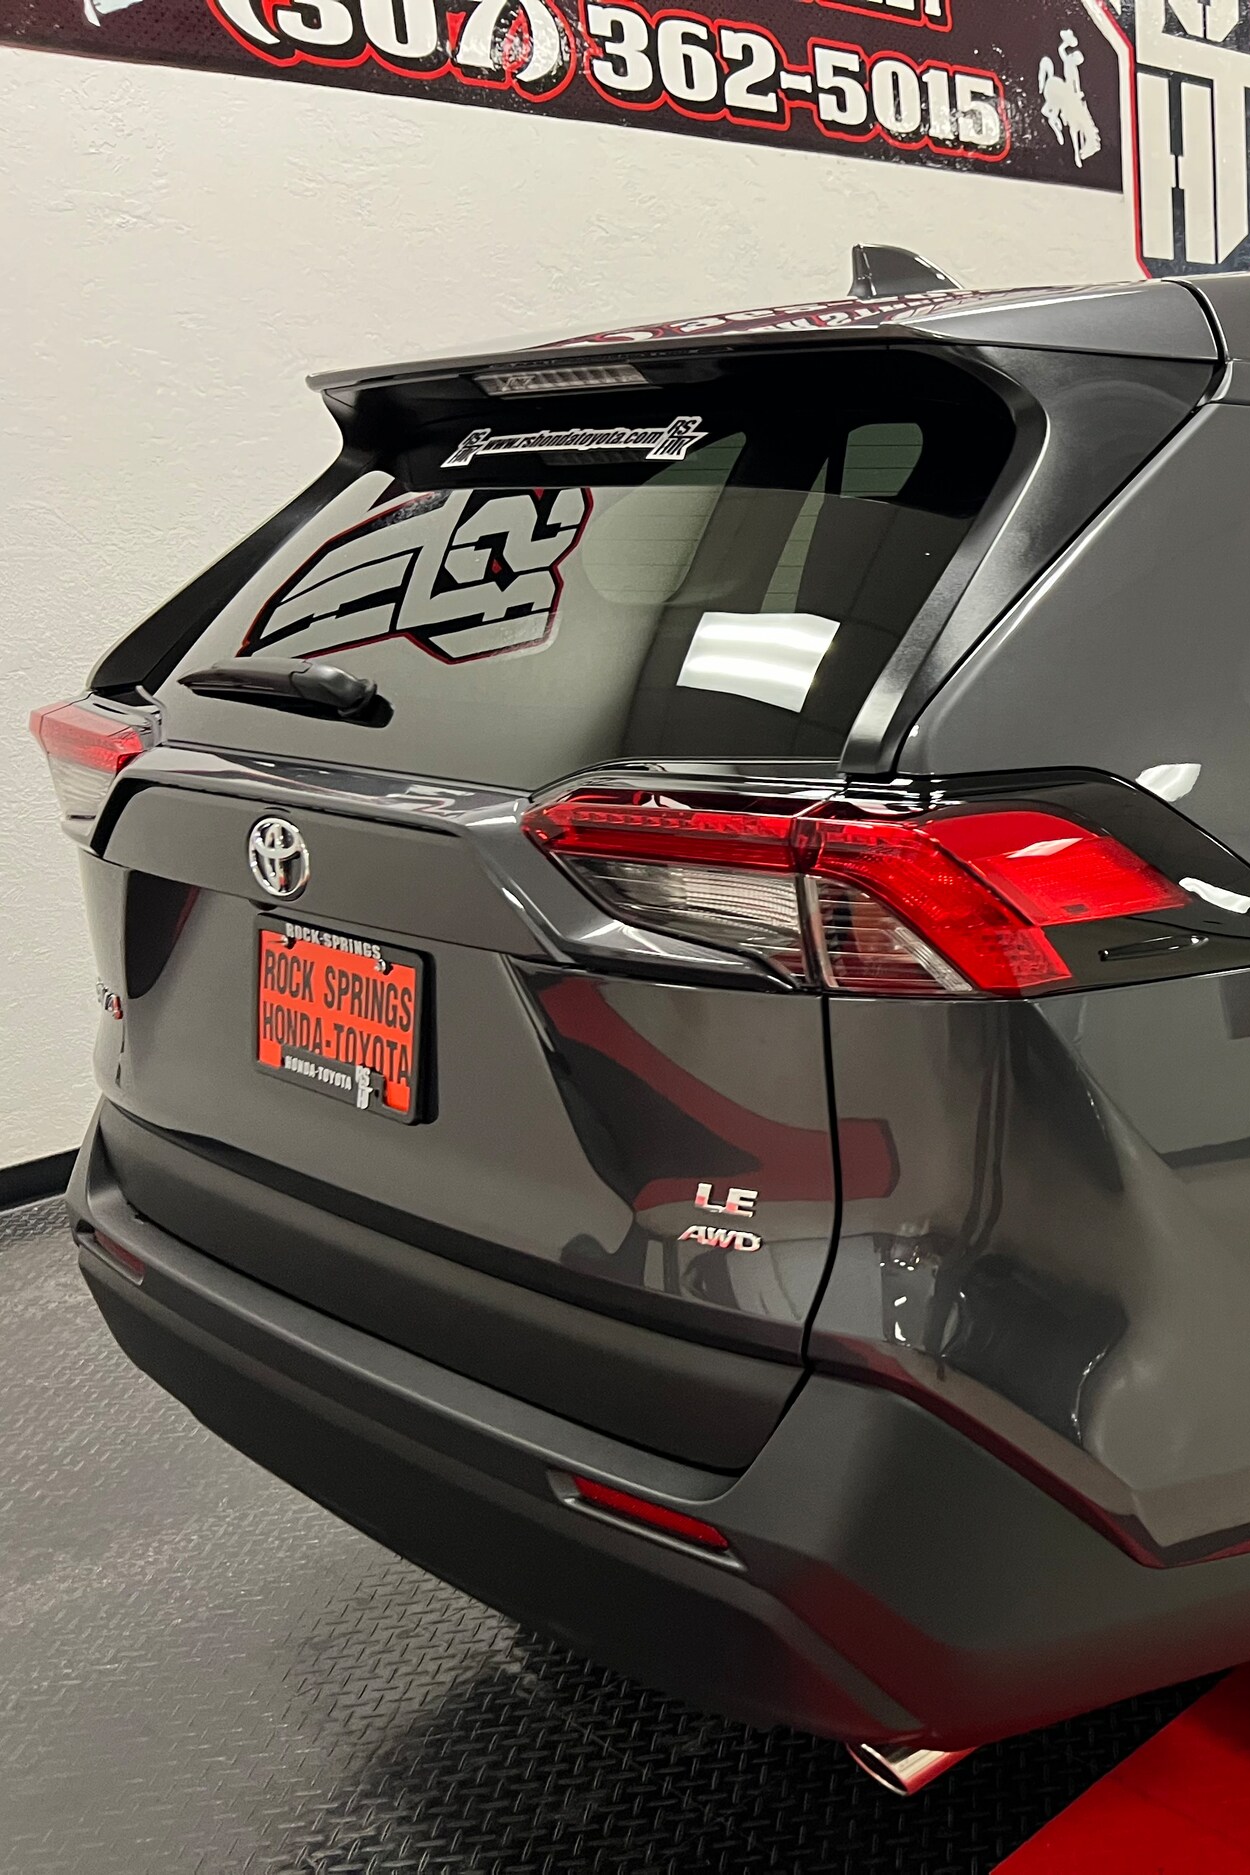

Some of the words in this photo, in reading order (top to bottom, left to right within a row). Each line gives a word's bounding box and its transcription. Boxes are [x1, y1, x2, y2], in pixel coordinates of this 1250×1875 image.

[589, 5, 1000, 147] 362-5015
[487, 428, 663, 450] www.rshondatoyota.com
[285, 922, 382, 960] ROCK-SPRINGS
[263, 949, 315, 1003] ROCK
[323, 965, 412, 1032] SPRINGS
[262, 1000, 410, 1086] HONDA-TOYOTA
[284, 1054, 352, 1091] HONDA-TOYOTA
[695, 1182, 759, 1218] LE
[677, 1225, 762, 1252] AWD
